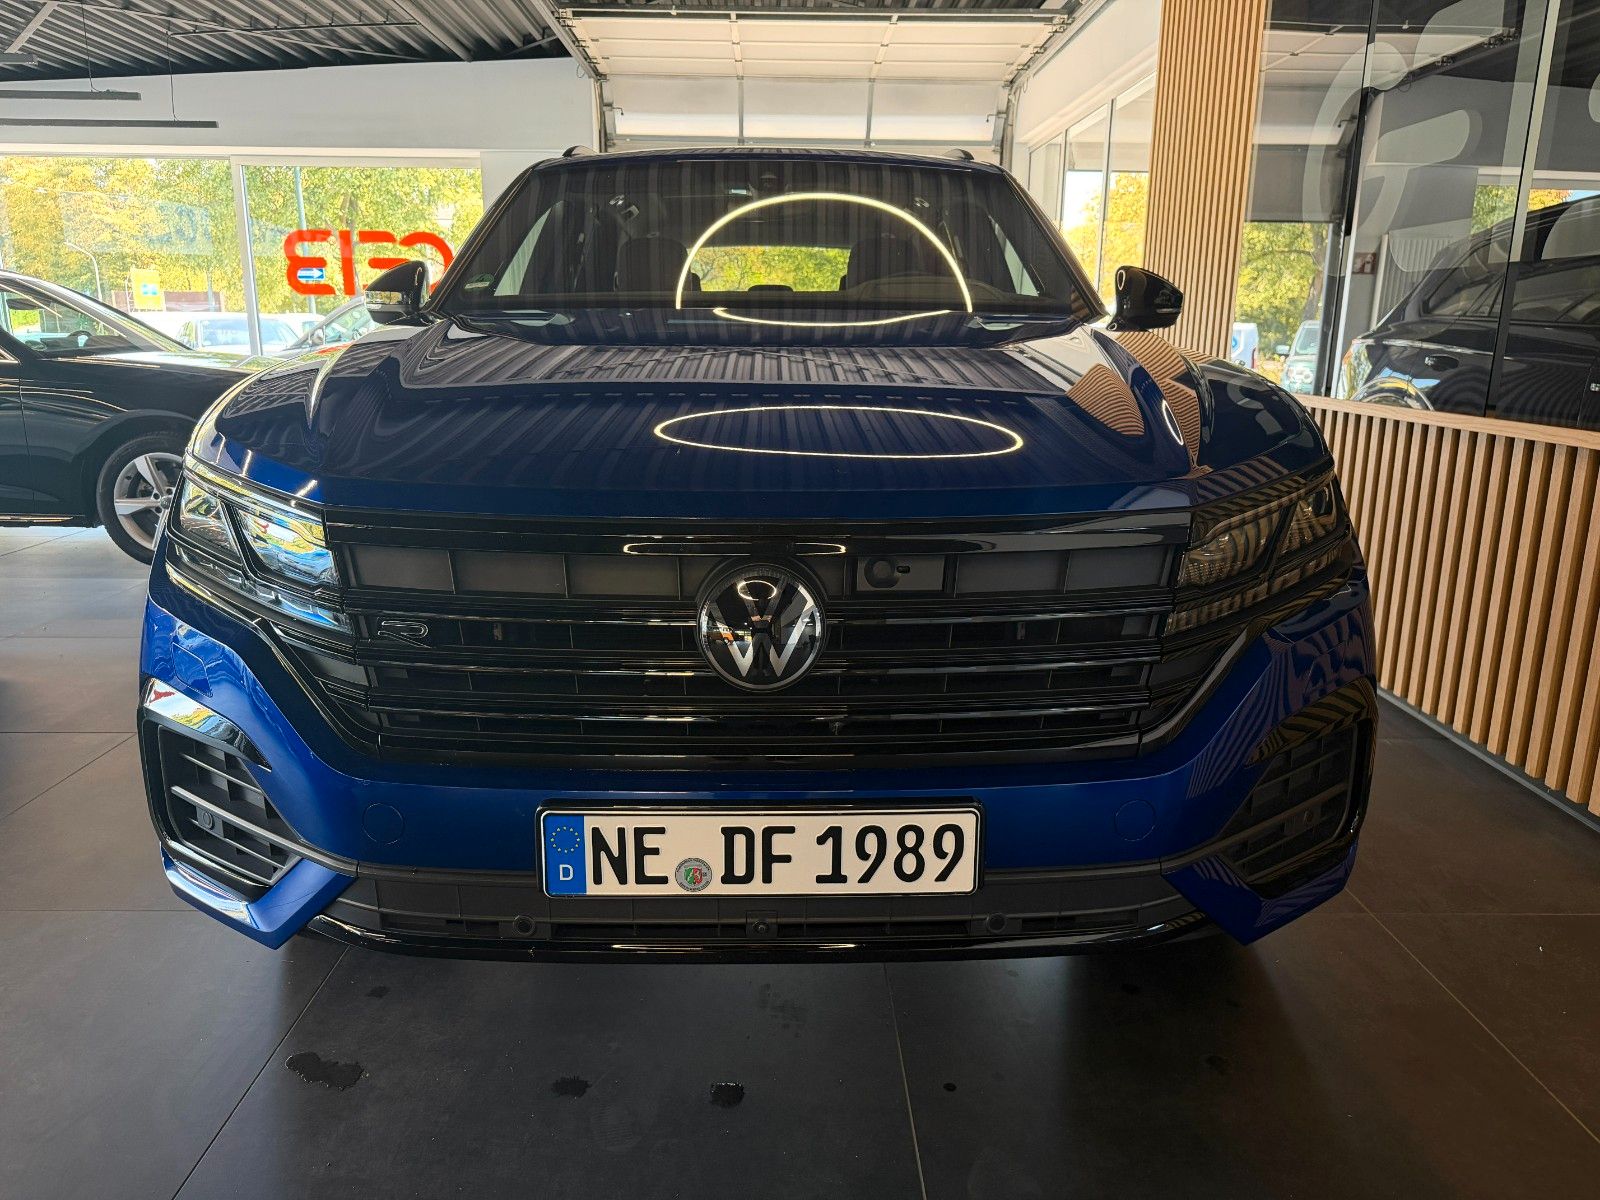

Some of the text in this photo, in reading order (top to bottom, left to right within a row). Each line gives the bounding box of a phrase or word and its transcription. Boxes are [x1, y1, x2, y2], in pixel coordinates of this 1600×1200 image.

[701, 570, 821, 688] VW
[559, 864, 574, 881] D
[591, 826, 669, 885] NE
[720, 825, 796, 884] DF
[815, 823, 965, 884] 1989
